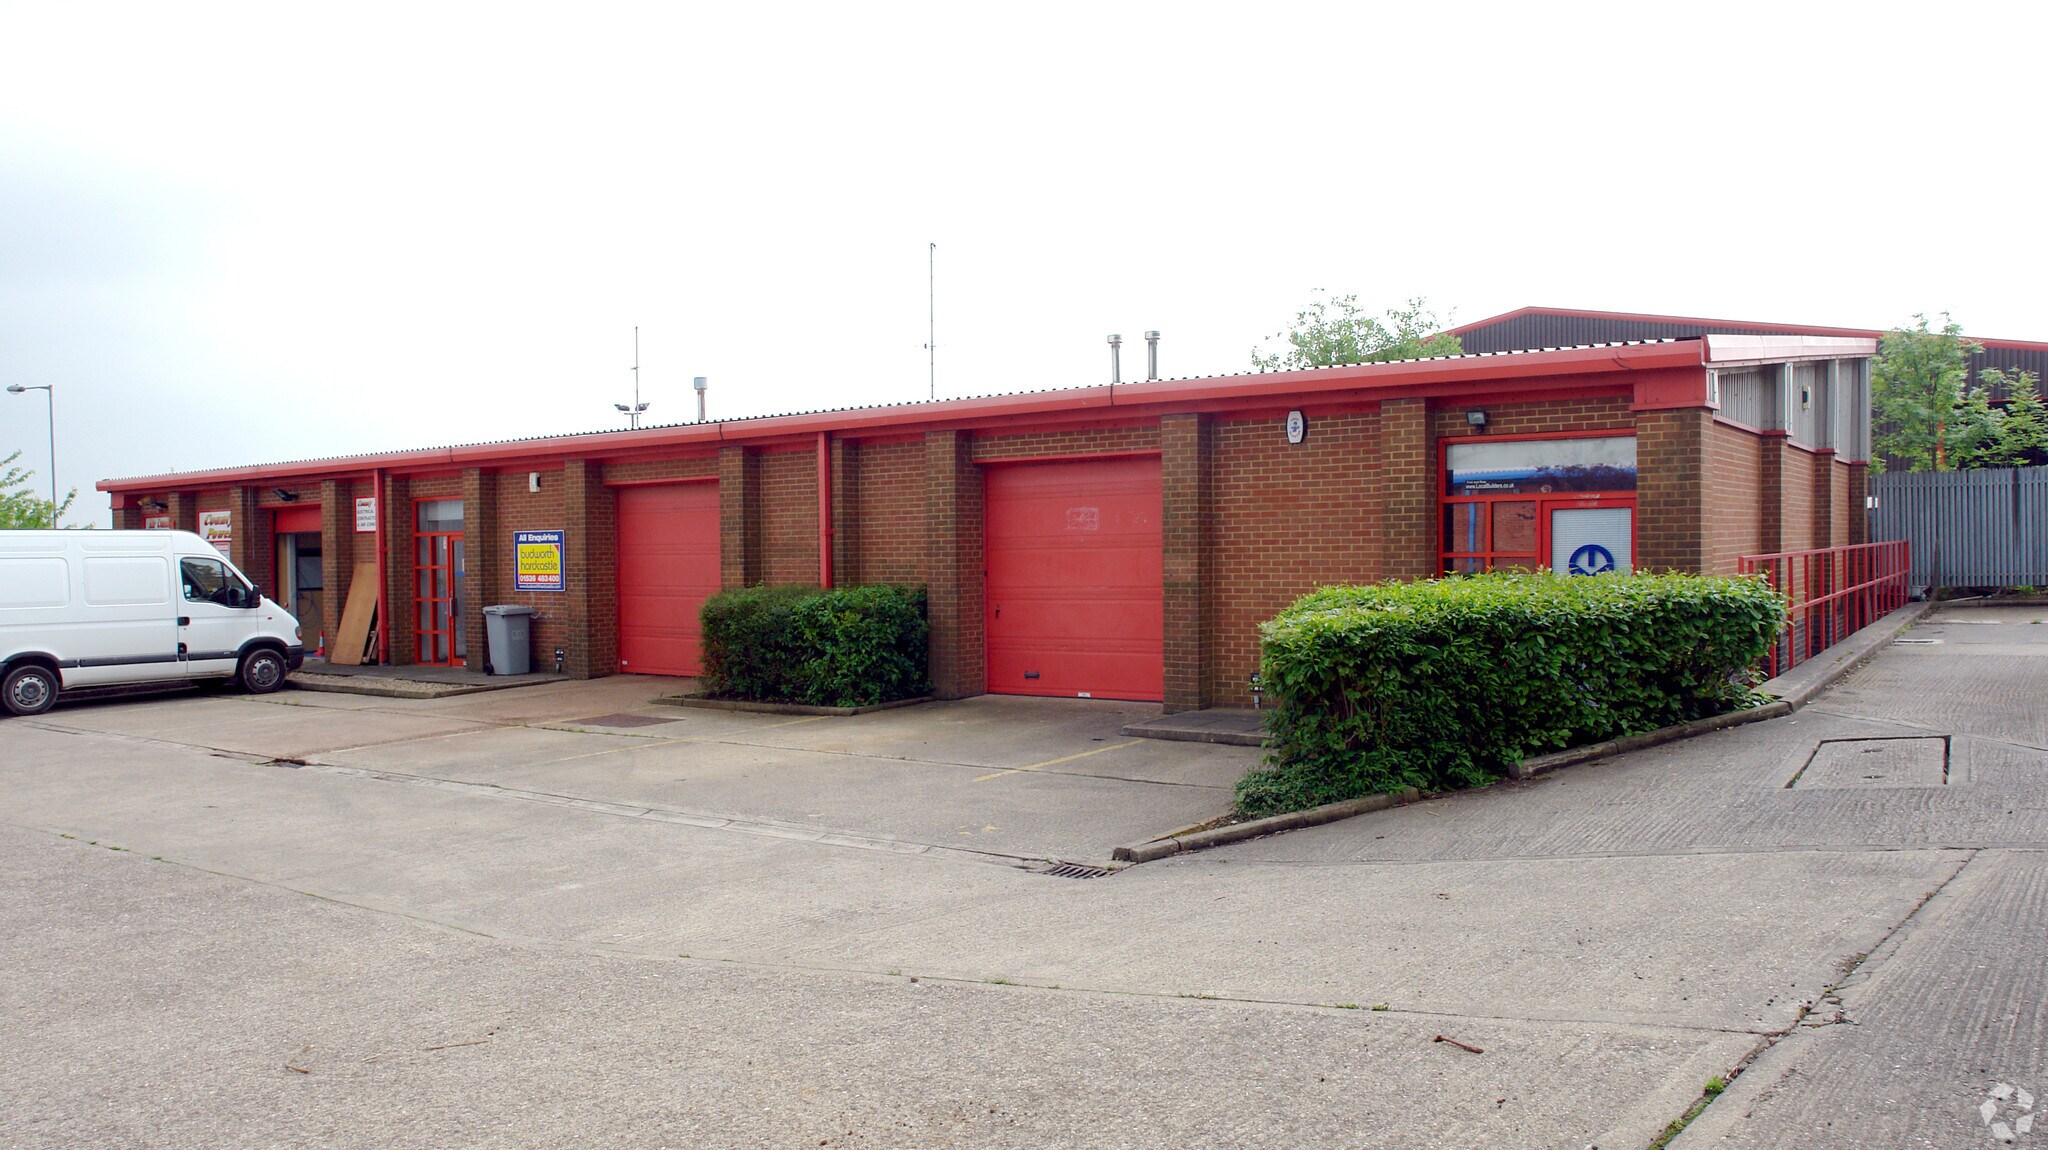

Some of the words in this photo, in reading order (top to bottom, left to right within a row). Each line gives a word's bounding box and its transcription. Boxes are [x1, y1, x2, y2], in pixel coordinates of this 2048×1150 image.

[519, 534, 527, 542] All
[528, 533, 559, 542] Enquiries
[520, 545, 555, 559] budworth
[520, 560, 558, 571] hardcastle
